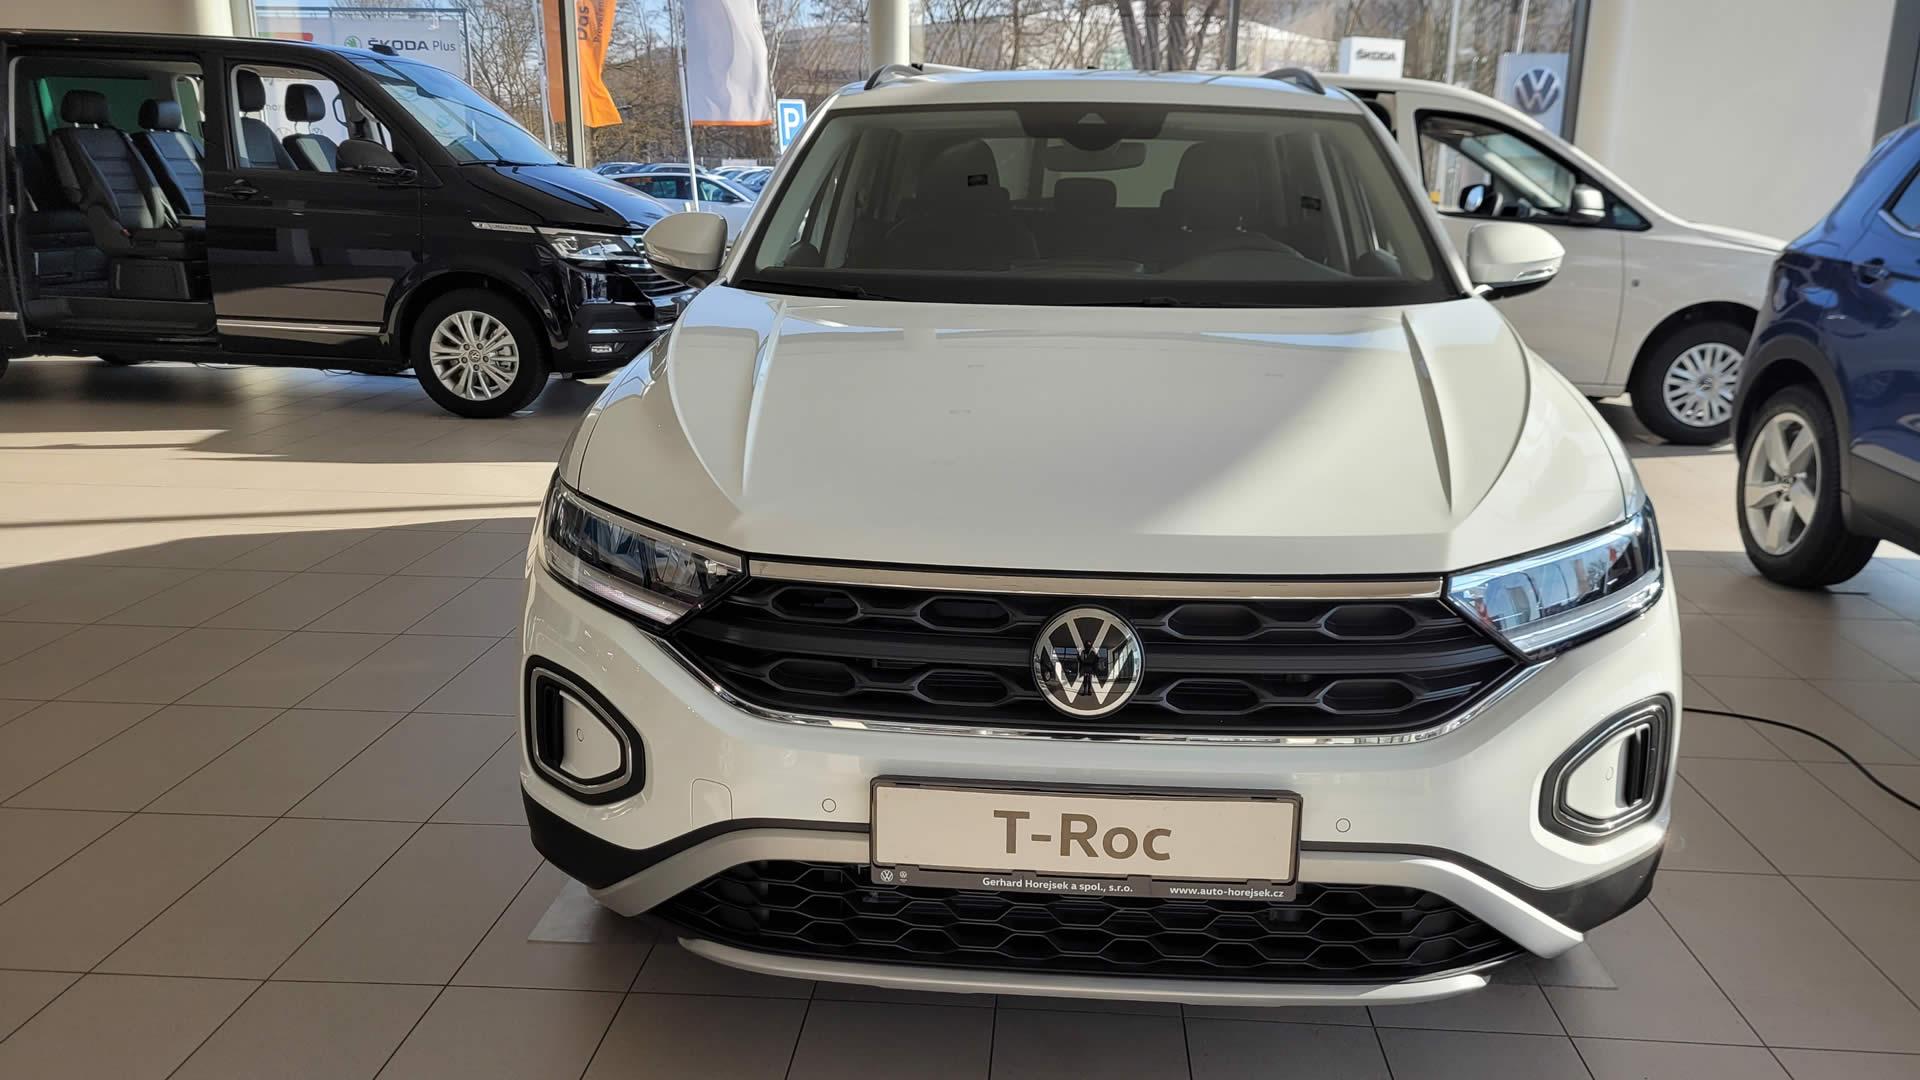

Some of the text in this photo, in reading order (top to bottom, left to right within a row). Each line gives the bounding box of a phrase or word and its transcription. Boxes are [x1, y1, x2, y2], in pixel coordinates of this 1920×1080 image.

[432, 41, 456, 52] Plus
[783, 107, 800, 140] P
[993, 809, 1172, 861] T-Roc
[982, 877, 1133, 893] Gerhard Horejsek a spol., s.r.o.
[1169, 887, 1285, 898] www.auto-horejsek.cz
